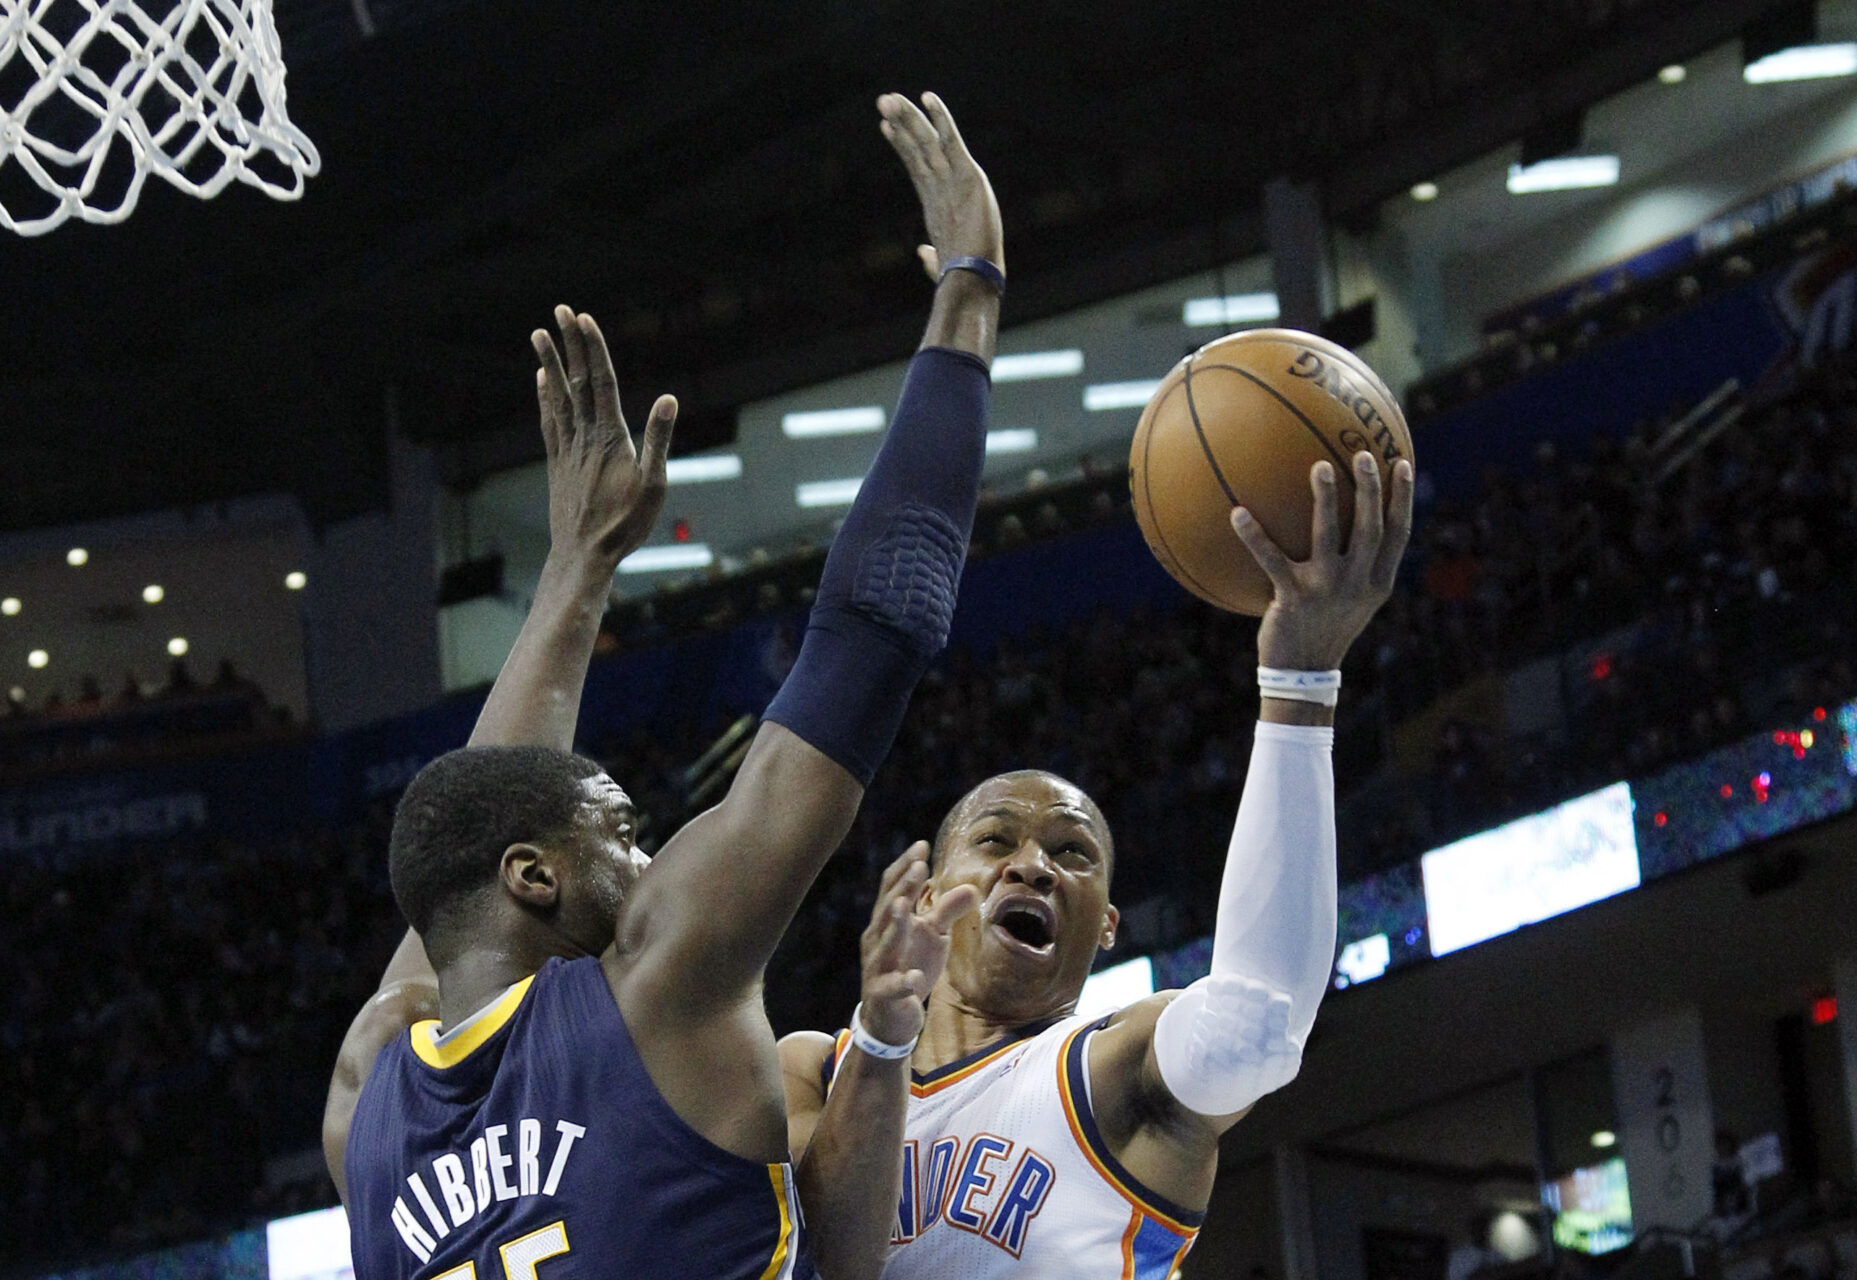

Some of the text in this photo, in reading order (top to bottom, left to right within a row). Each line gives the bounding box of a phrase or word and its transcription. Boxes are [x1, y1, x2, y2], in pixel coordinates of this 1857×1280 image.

[1287, 351, 1401, 461] ALDING
[391, 1118, 586, 1264] HIBBERT
[890, 1132, 1056, 1260] NDER
